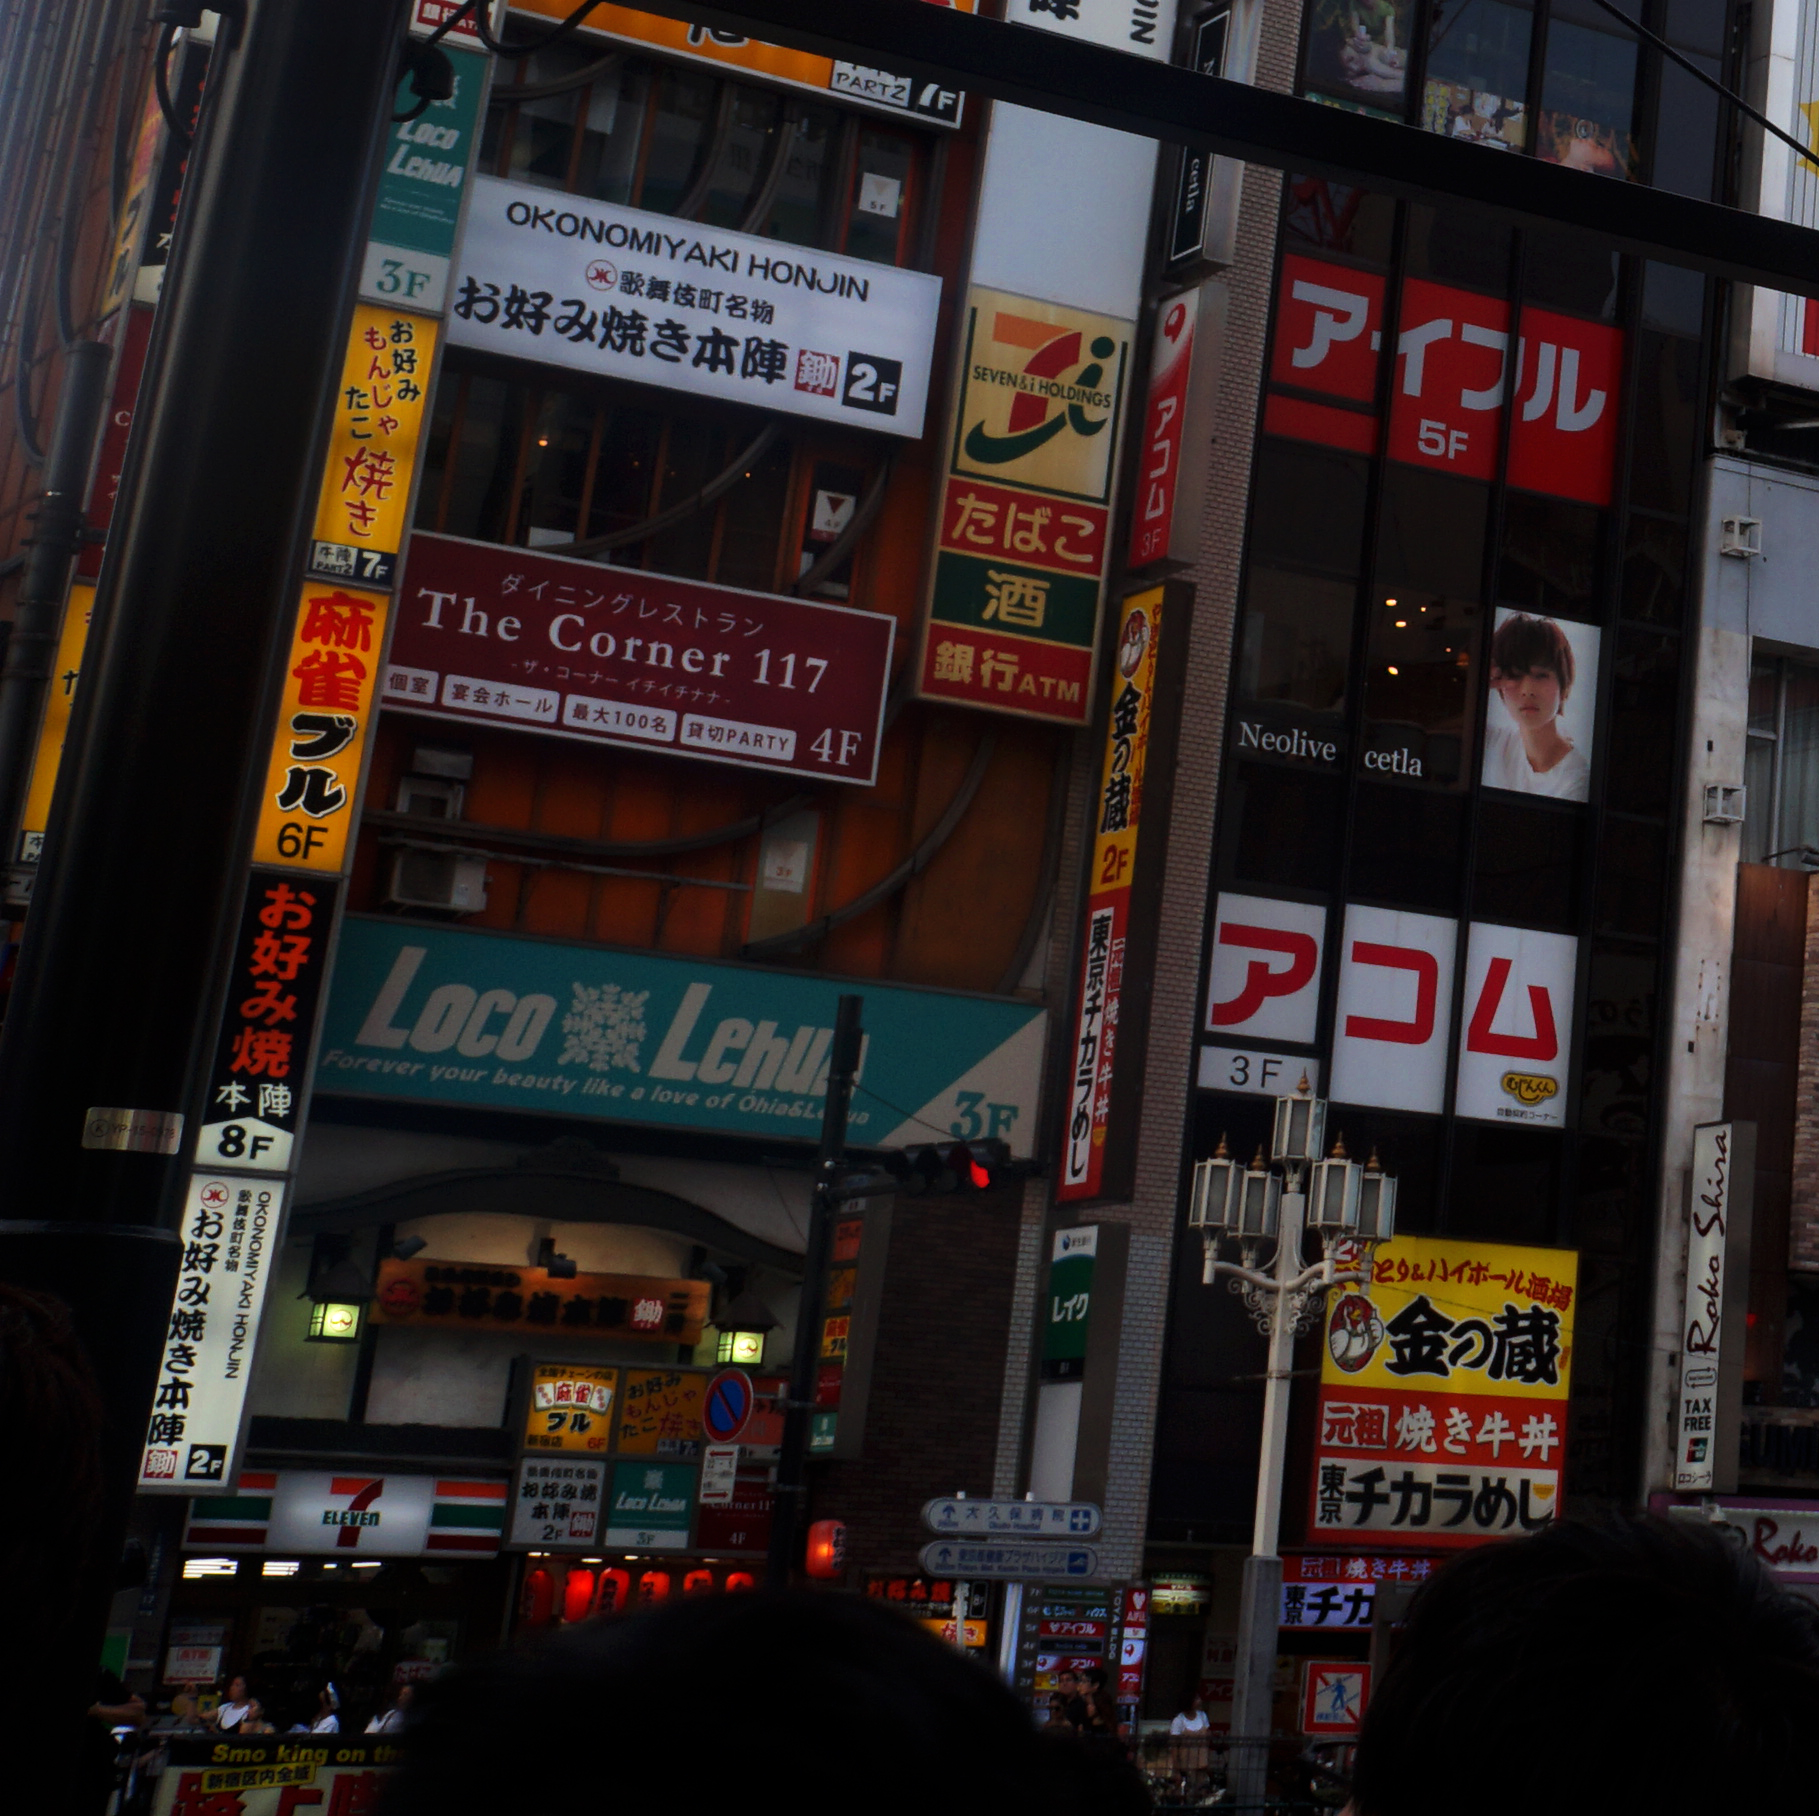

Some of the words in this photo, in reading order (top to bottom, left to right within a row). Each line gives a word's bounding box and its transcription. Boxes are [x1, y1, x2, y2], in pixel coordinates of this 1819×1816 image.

[376, 260, 430, 298] 3F
[507, 201, 740, 274] OKONOMIYAKI
[747, 253, 869, 302] HONJIN
[620, 270, 775, 325] 歌舞伎町名物
[389, 320, 421, 401] お好み
[454, 277, 789, 384] お好み焼き本陣
[848, 360, 897, 403] 2F
[1292, 279, 1608, 433] アイフル
[364, 326, 399, 435] もんじゃ
[1038, 378, 1112, 409] HOLDINGS
[1145, 395, 1178, 521] アコム
[1417, 419, 1469, 460] 5F
[951, 493, 1096, 565] たばこ
[1141, 528, 1162, 557] 3F
[361, 550, 389, 579] 7F
[500, 572, 764, 638] ダイニングレストラン
[981, 569, 1051, 628] 酒
[292, 590, 375, 712] 麻雀
[417, 586, 523, 642] The
[548, 614, 731, 678] Corner
[753, 648, 828, 694] 117
[933, 639, 1081, 704] 銀行ATM
[452, 686, 552, 715] 宴会ホール
[572, 702, 668, 735] 最大100名
[809, 727, 862, 767] 4F
[1237, 721, 1337, 763] Neolive
[1364, 746, 1424, 779] cetla
[274, 712, 358, 817] ブル
[277, 821, 328, 860] 6F
[1101, 844, 1129, 884] 2F
[229, 882, 318, 1080] お好み焼
[1211, 921, 1559, 1062] アコム
[1062, 913, 1114, 1179] 東京チカラめし
[1230, 1055, 1284, 1088] 3F
[214, 1081, 292, 1119] 本陣
[322, 1048, 425, 1077] Forever
[429, 1059, 486, 1084] your
[491, 1066, 578, 1096] beauty
[583, 1077, 623, 1100] like
[629, 1084, 645, 1102] a
[651, 1085, 697, 1106] love
[704, 1091, 734, 1111] of
[217, 1126, 274, 1162] 8F
[950, 1091, 1018, 1143] 3F
[238, 1191, 271, 1311] OKONOMIYAKI
[1051, 1290, 1090, 1325] レイク
[224, 1312, 251, 1380] HONJIN
[546, 1413, 592, 1433] ブル
[1322, 1402, 1388, 1449] 元祖
[1393, 1404, 1560, 1463] 焼き牛丼
[1684, 1398, 1712, 1414] TAX
[1684, 1415, 1712, 1433] FREE
[188, 1448, 222, 1475] 2F
[322, 1509, 380, 1527] ELEVEN
[1319, 1463, 1348, 1525] 東京
[1347, 1465, 1554, 1531] チカラめし
[543, 1524, 563, 1541] 2F
[728, 1531, 747, 1545] 4F
[1752, 1517, 1819, 1566] Roko
[335, 1748, 366, 1763] on
